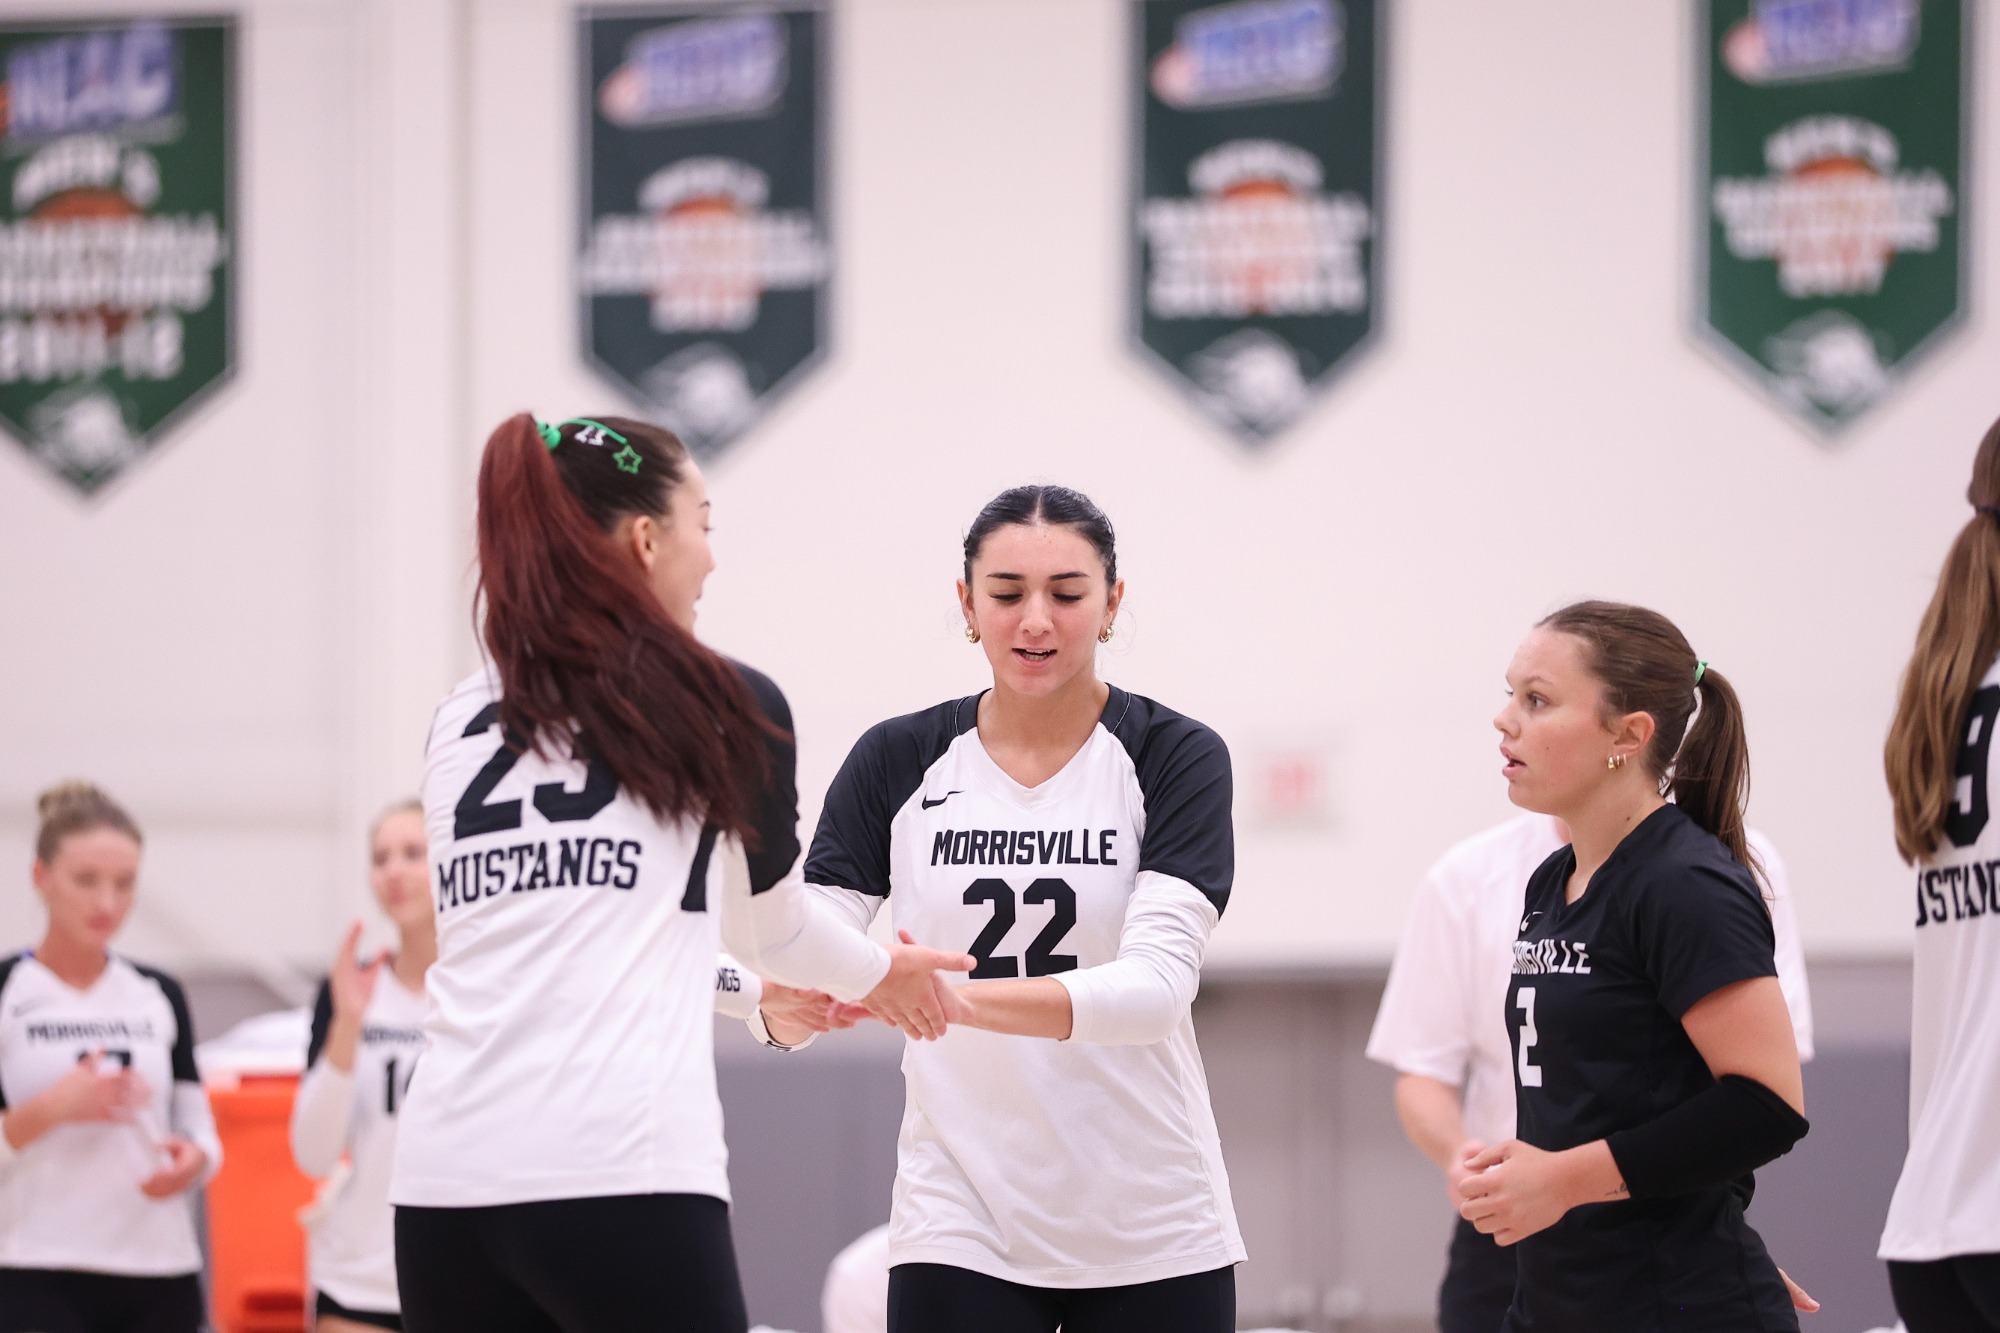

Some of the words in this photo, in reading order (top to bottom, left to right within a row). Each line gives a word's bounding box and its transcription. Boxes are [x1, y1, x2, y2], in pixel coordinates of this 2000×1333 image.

[438, 837, 643, 913] MUSTANGS
[931, 828, 1118, 867] MORRISVILLE
[962, 878, 1078, 980] 22
[1516, 987, 1543, 1088] 2
